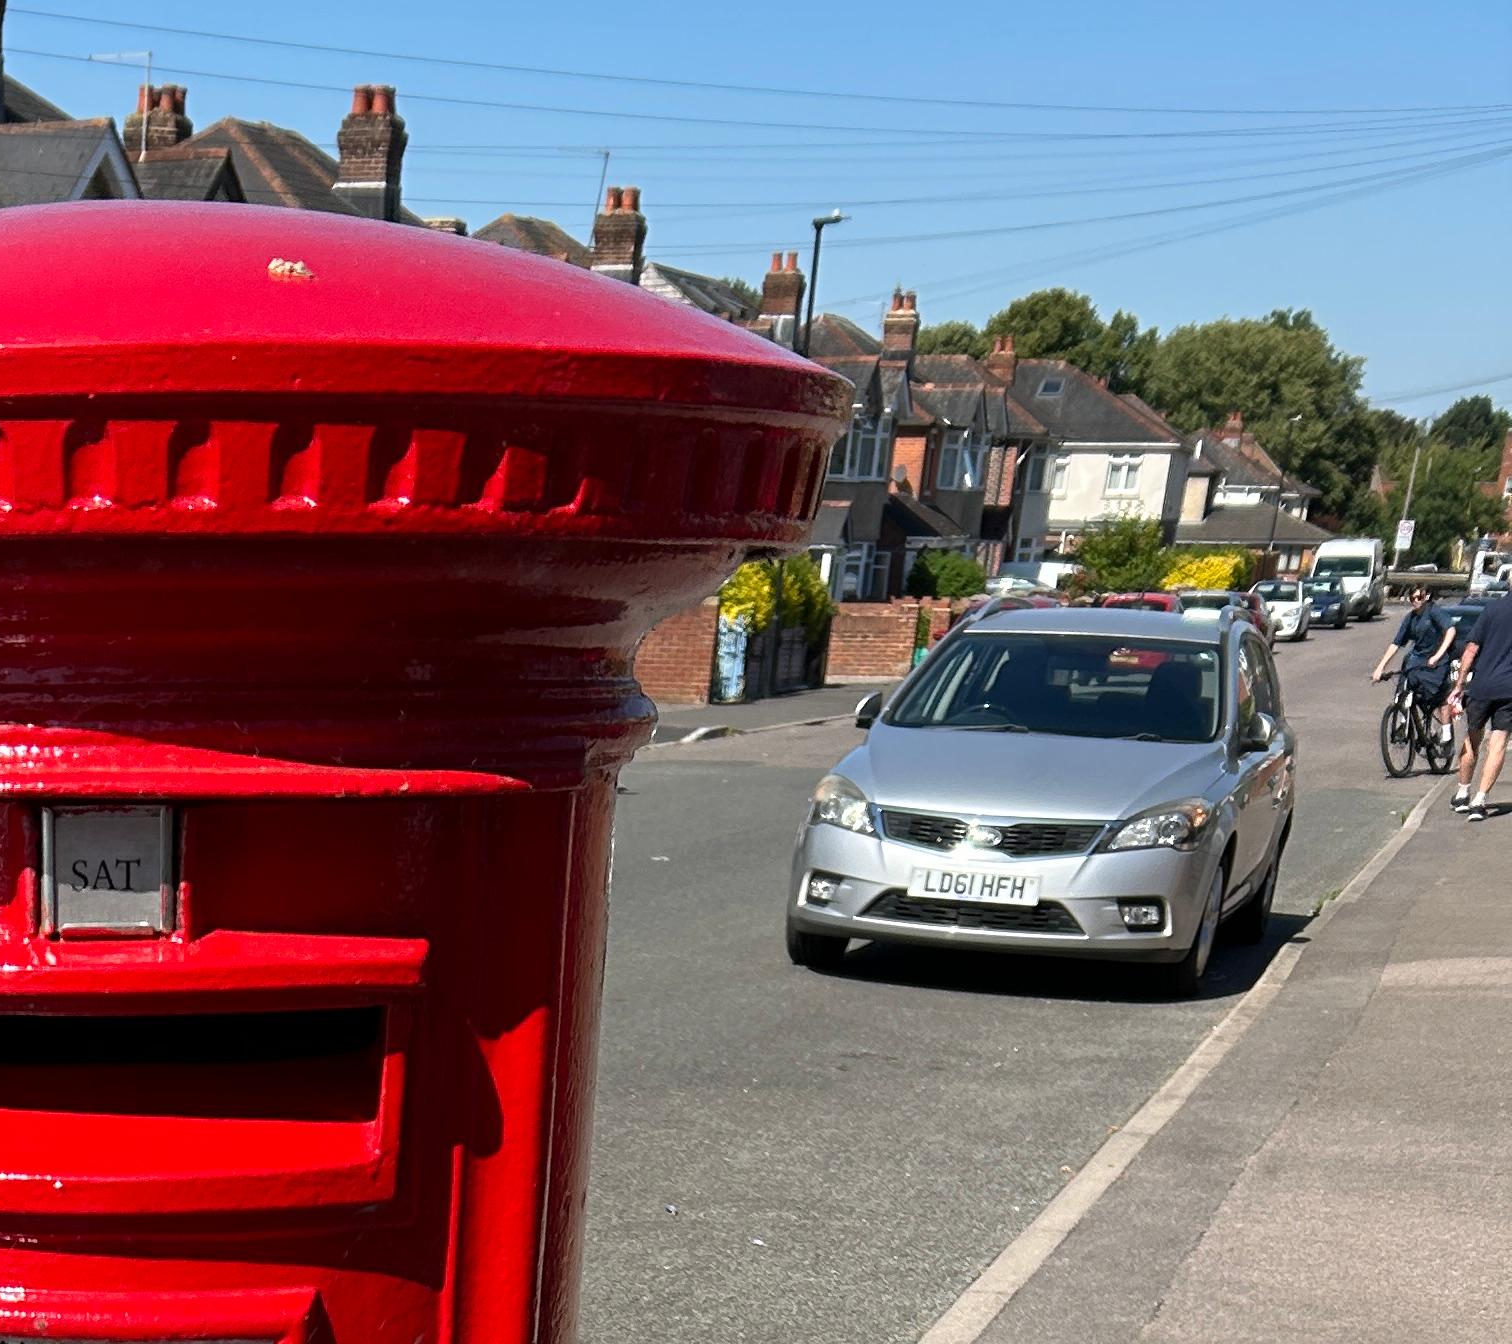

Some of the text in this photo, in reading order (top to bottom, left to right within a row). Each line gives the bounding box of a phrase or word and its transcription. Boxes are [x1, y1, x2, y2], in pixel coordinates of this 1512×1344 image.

[71, 858, 142, 892] SAT
[923, 871, 1026, 899] LD61 HFH
